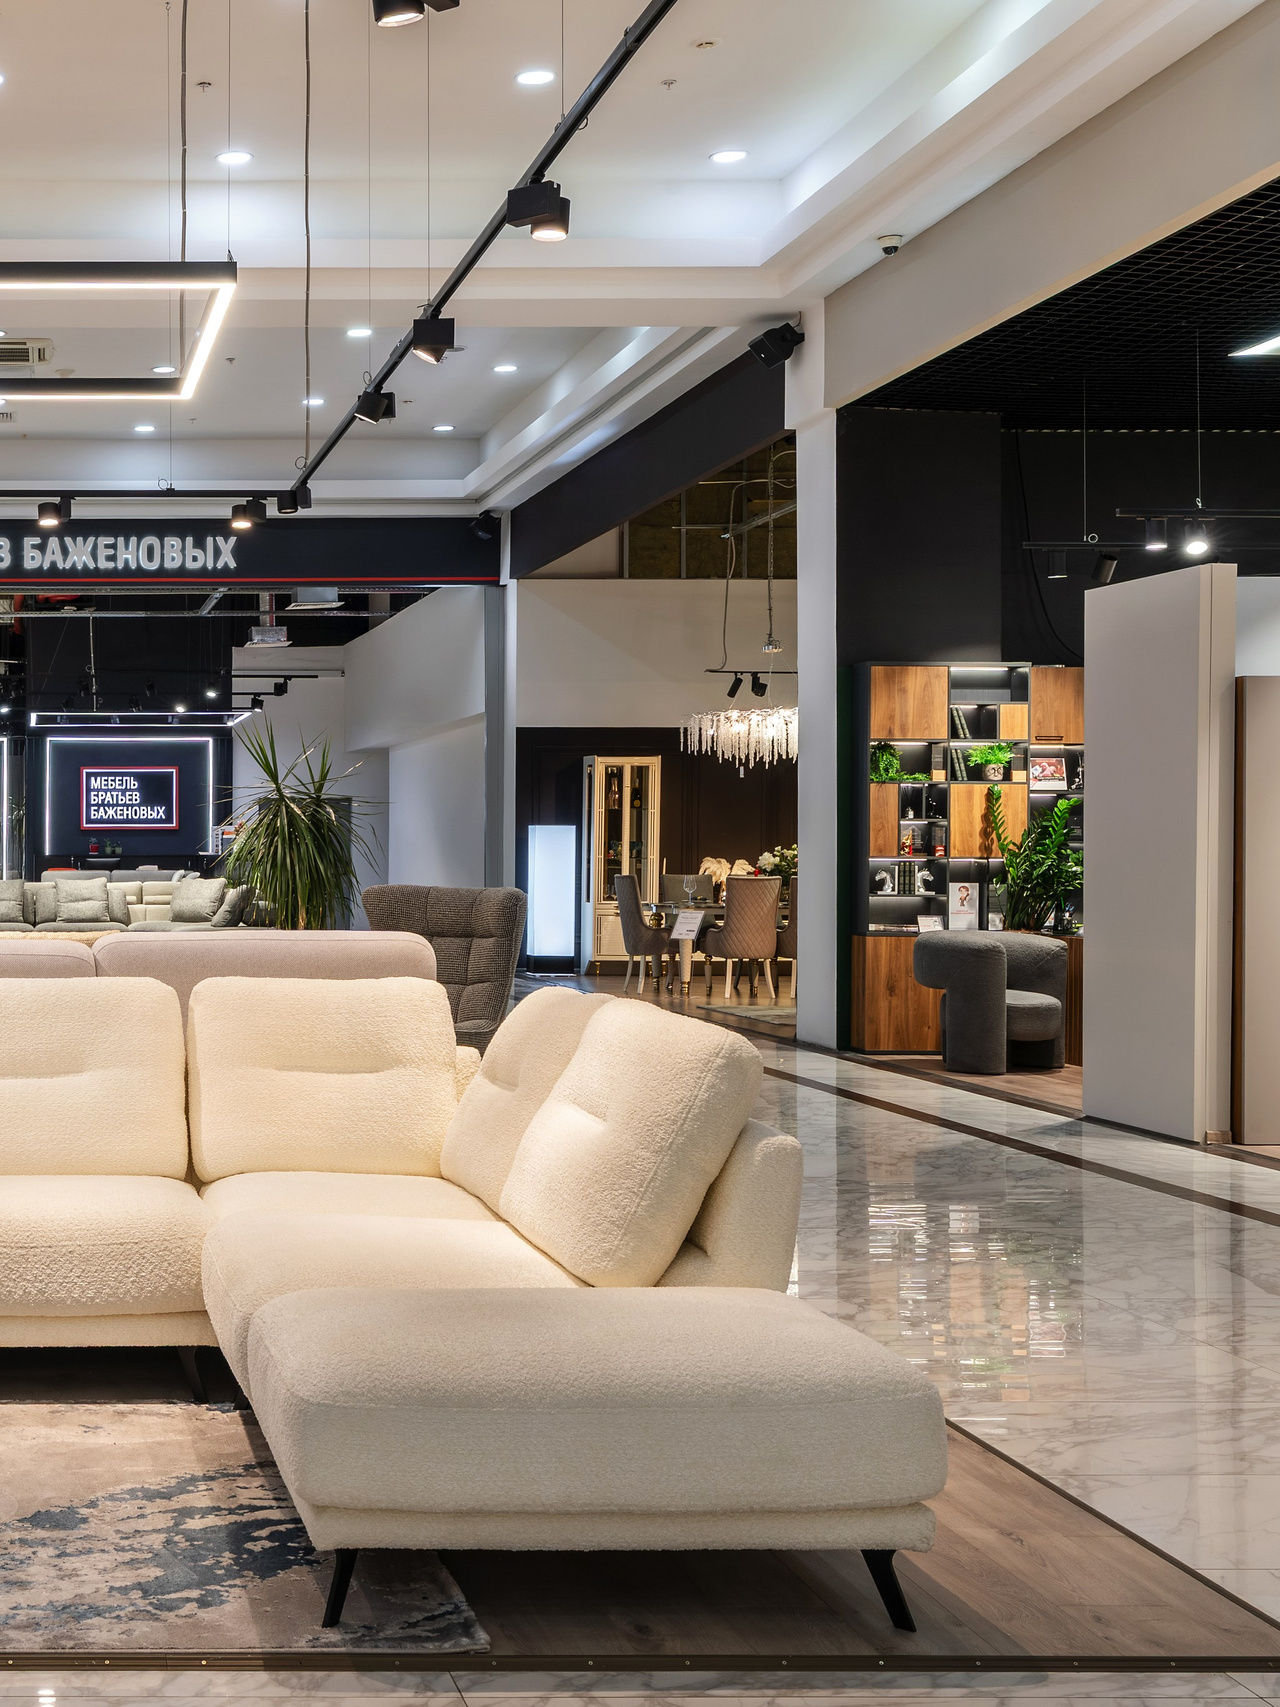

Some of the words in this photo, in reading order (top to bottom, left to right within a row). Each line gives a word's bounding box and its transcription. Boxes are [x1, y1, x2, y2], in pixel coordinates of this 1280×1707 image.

[23, 535, 238, 570] БАЖЕНОВЫХ
[90, 776, 138, 790] МЕБЕЛЬ
[90, 791, 140, 804] БРАТЬЕВ
[90, 806, 166, 819] БАЖЕНОВЫХ
